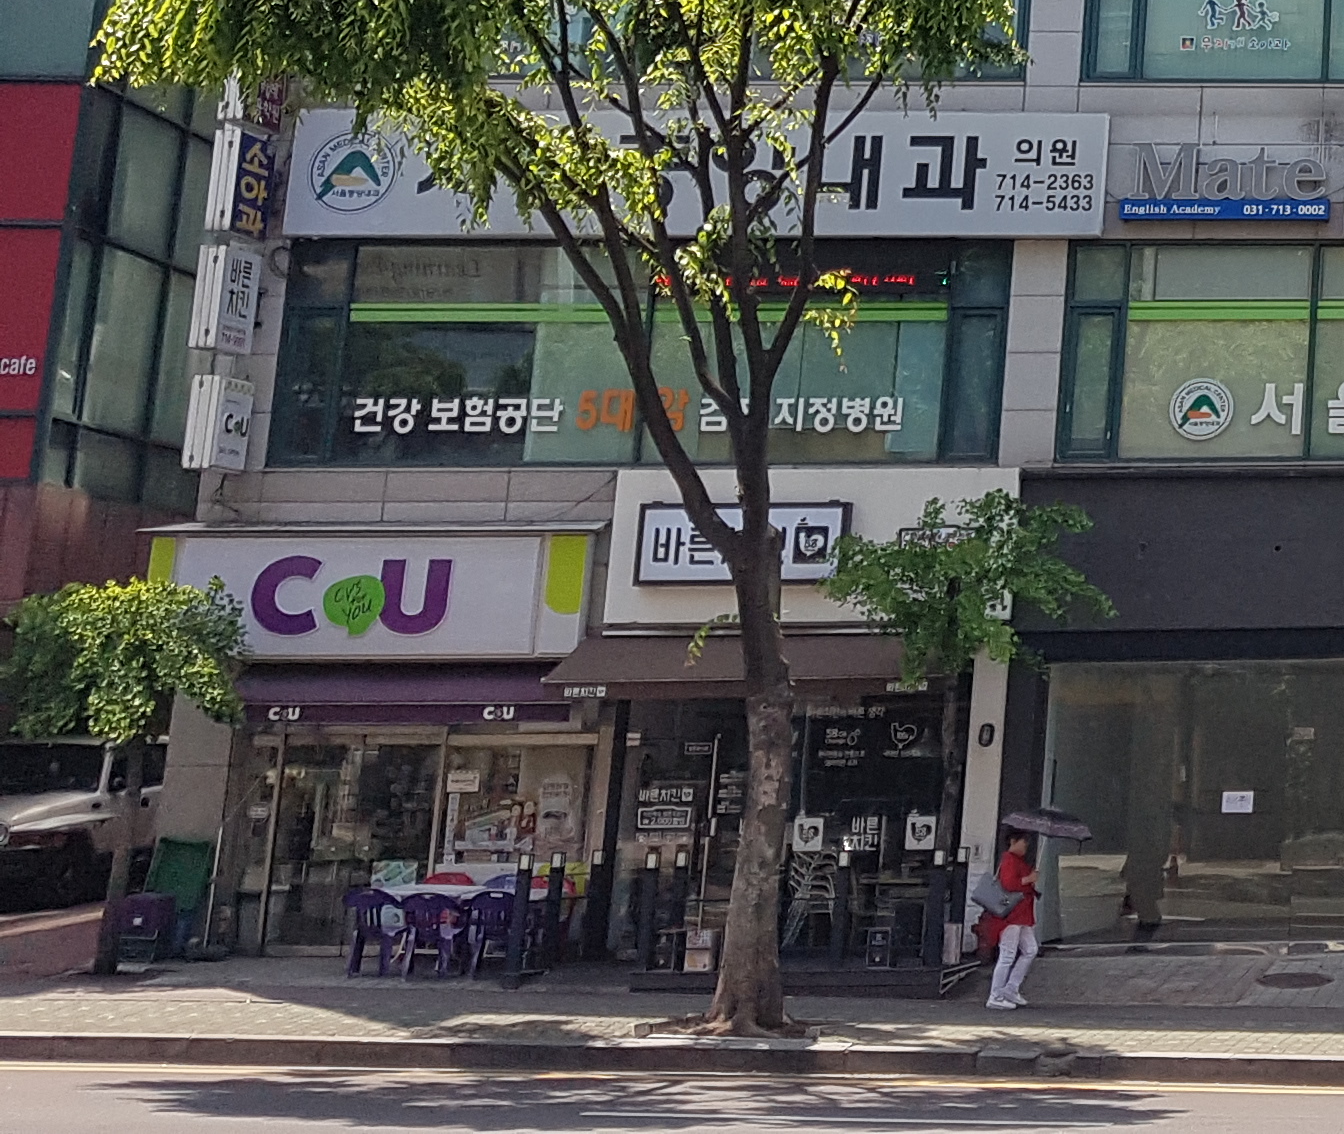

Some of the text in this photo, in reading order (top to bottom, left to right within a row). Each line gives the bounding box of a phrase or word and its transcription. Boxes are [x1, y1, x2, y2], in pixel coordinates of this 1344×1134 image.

[1013, 139, 1079, 167] 의원
[1129, 141, 1328, 202] Mate
[234, 137, 272, 234] 소아과
[995, 173, 1095, 193] 714-2363
[993, 194, 1094, 214] 714-5433
[1123, 203, 1326, 218] English Academy 031-713-0002
[352, 397, 421, 434] 건강
[430, 396, 563, 435] 보험공단
[775, 396, 903, 434] 지정병원
[639, 788, 681, 802] 바른치킨
[851, 816, 880, 834] 바른
[849, 836, 878, 851] 치킨
